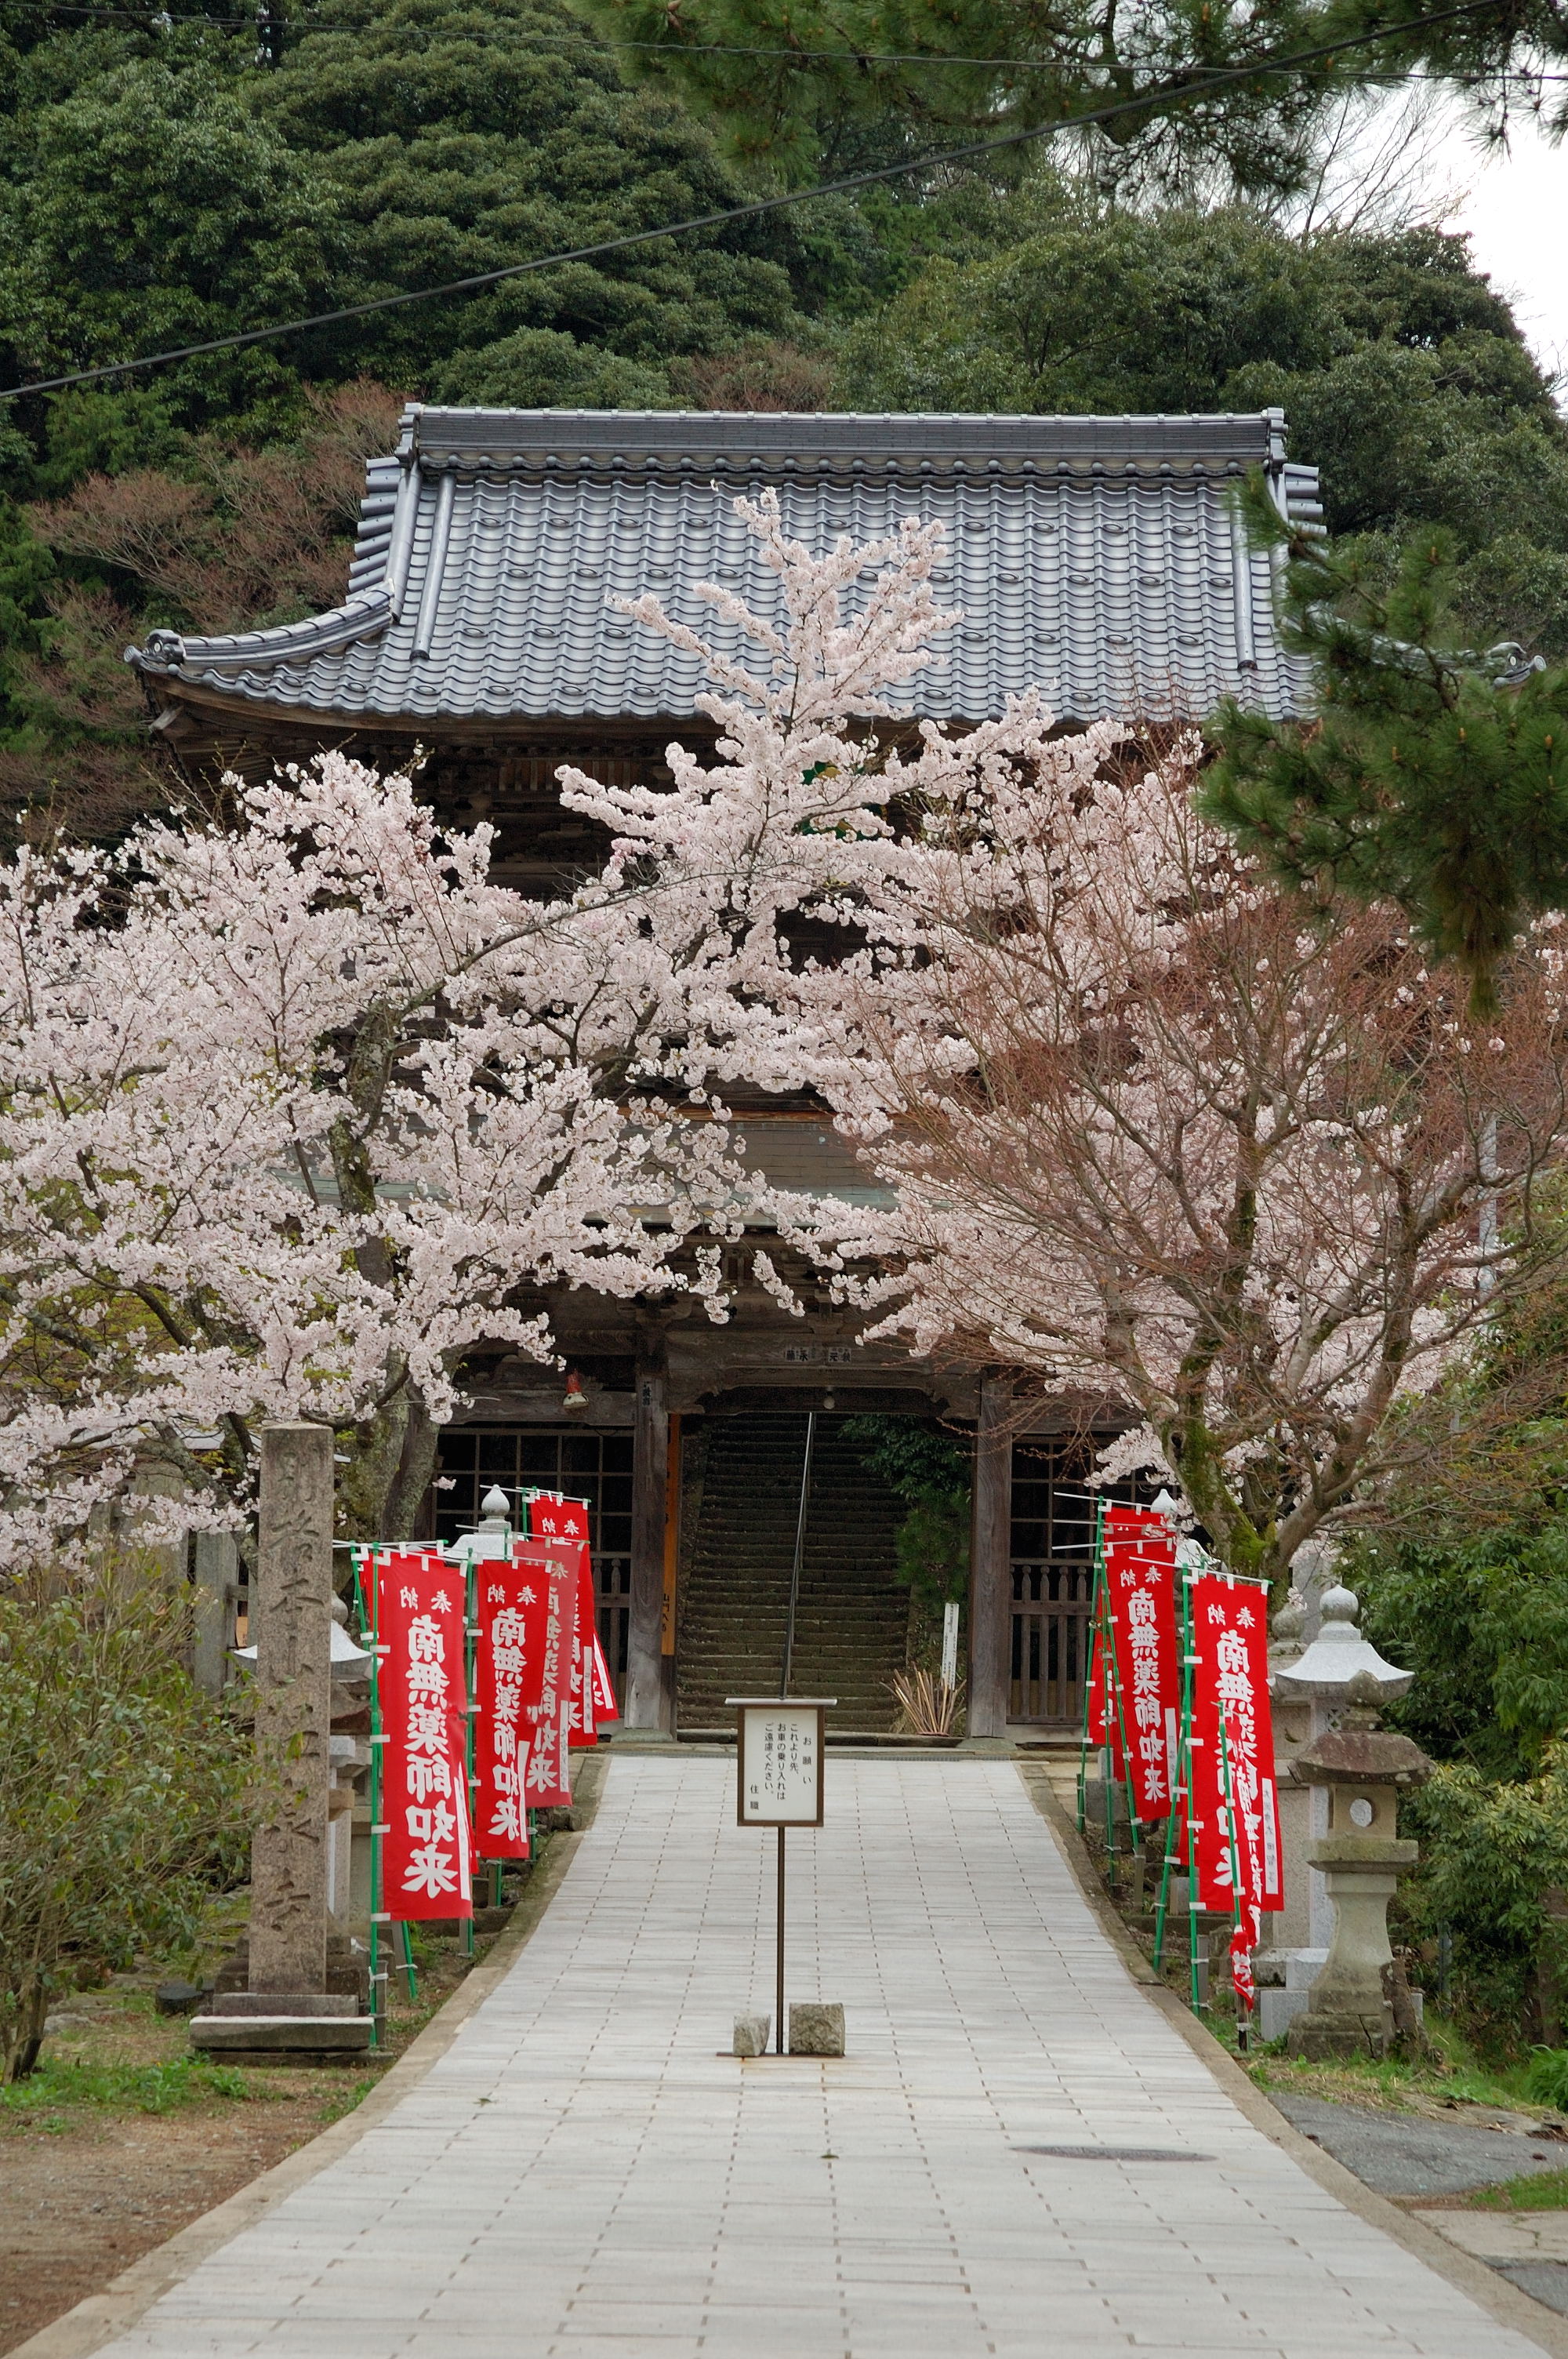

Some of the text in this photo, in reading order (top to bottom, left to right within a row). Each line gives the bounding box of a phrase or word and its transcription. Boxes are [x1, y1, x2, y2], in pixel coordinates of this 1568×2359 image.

[777, 1722, 786, 1801] お車の乗り入れは
[789, 1723, 799, 1774] これより先、
[802, 1736, 812, 1784] お願い
[750, 1784, 760, 1810] 住職
